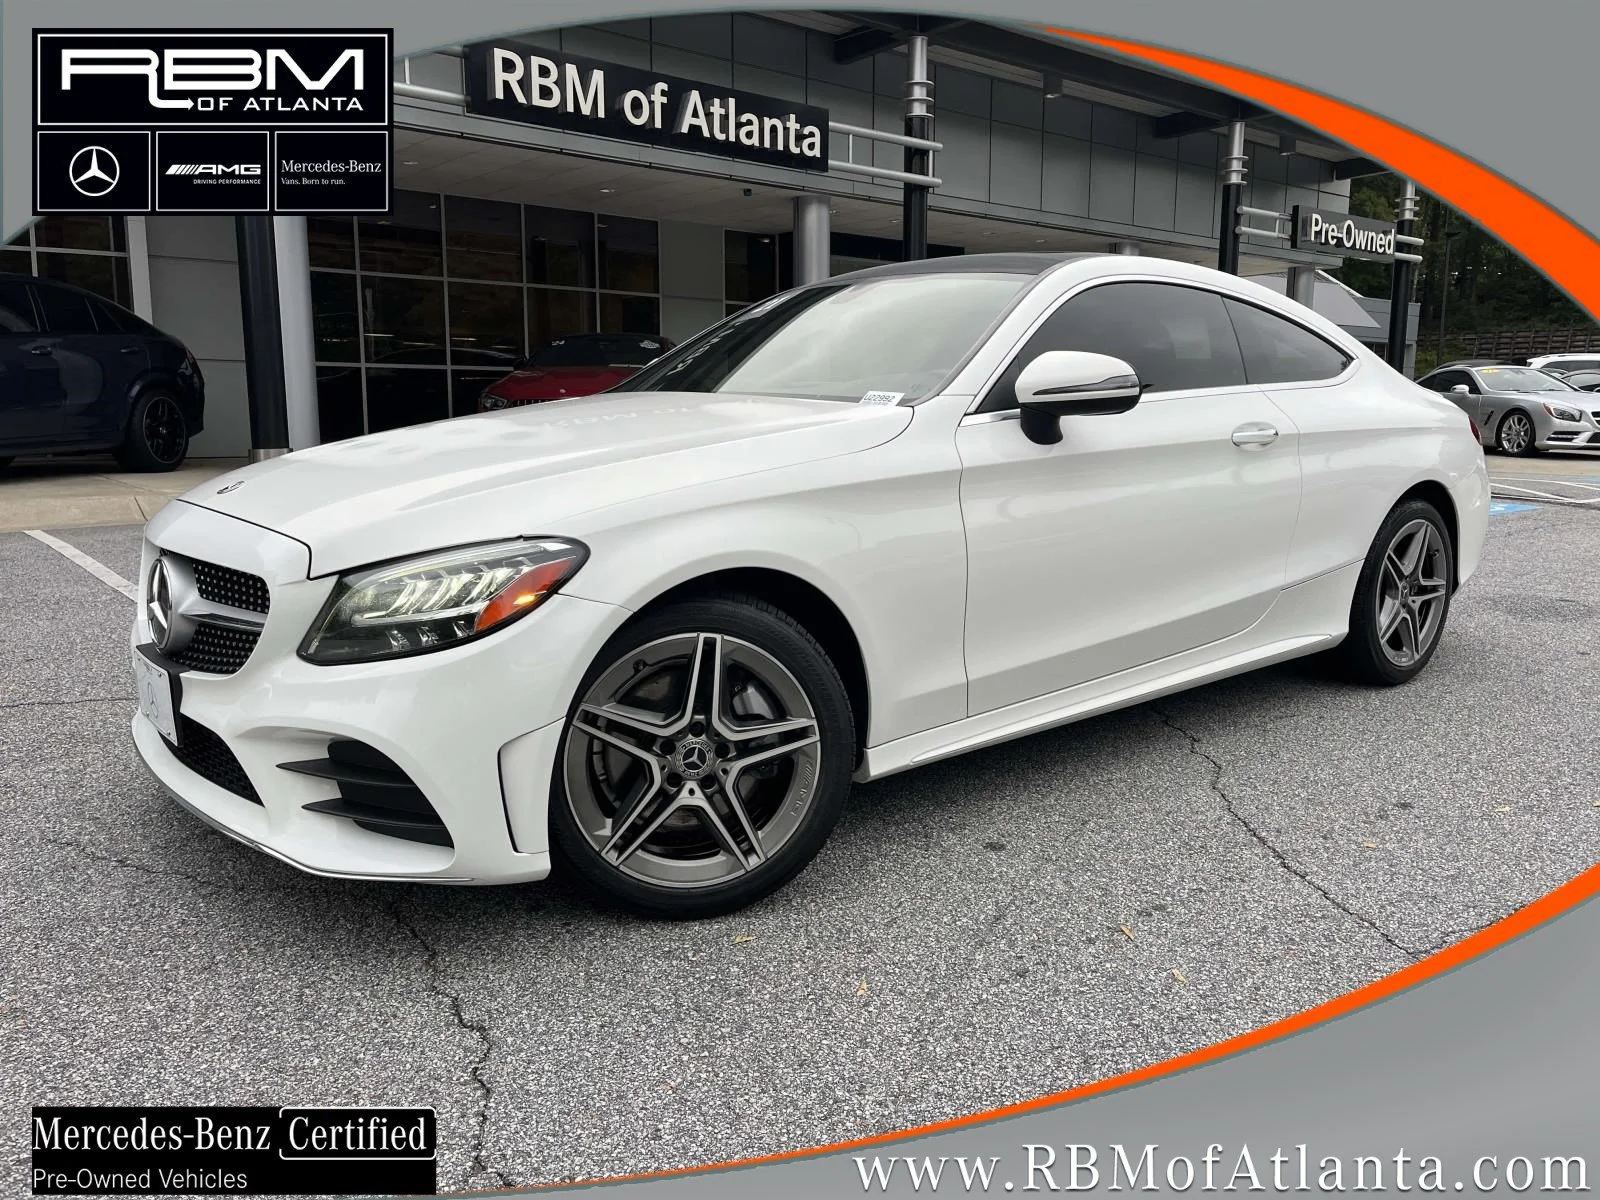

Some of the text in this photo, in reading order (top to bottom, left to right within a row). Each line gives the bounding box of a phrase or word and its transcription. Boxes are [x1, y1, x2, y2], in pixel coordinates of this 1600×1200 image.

[493, 47, 822, 158] RBM of Atlanta
[1310, 213, 1396, 255] Pre-Owned
